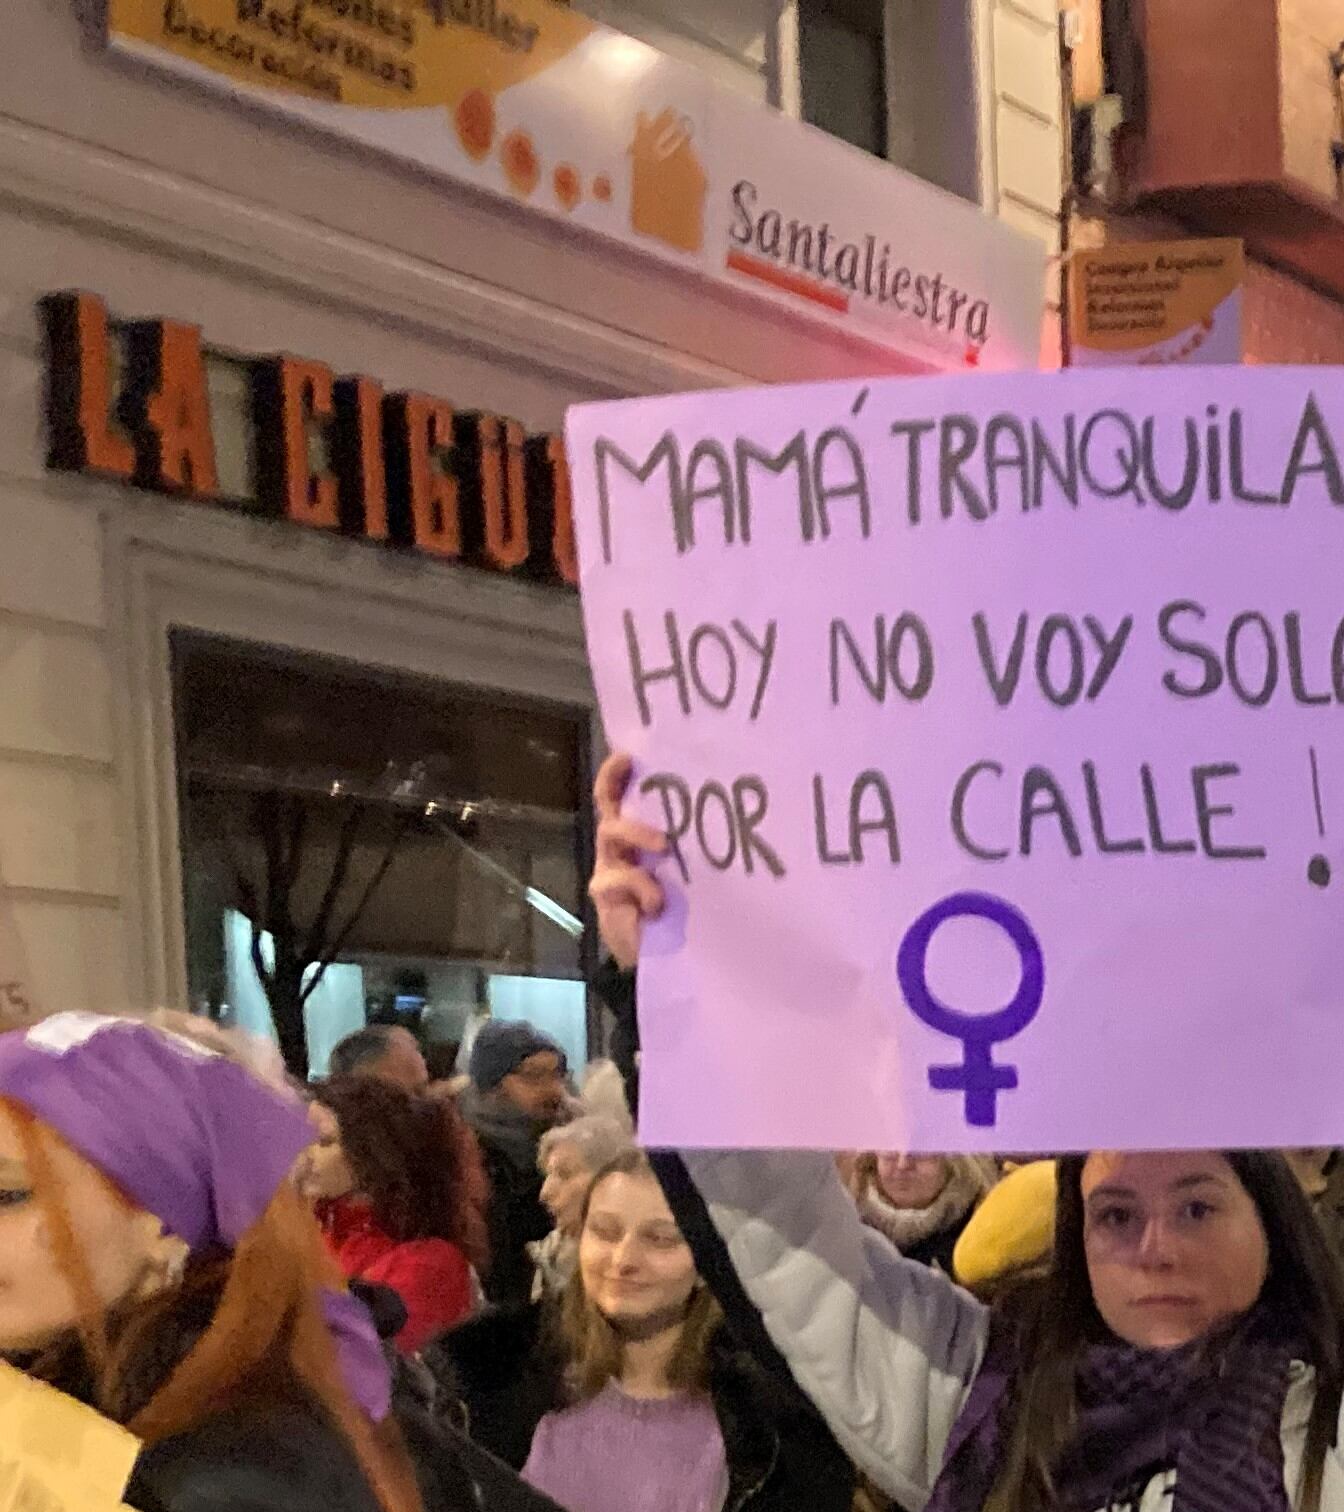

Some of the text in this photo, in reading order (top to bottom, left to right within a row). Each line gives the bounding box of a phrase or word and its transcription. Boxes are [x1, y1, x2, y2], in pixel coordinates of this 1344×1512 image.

[728, 179, 991, 345] Santaliestra
[72, 287, 220, 498] LA
[596, 388, 872, 566] MAMÁ
[624, 605, 779, 727] HOY
[828, 609, 937, 706] NO
[972, 610, 1134, 708] VOY
[638, 770, 787, 886] POR
[811, 769, 902, 868] LA
